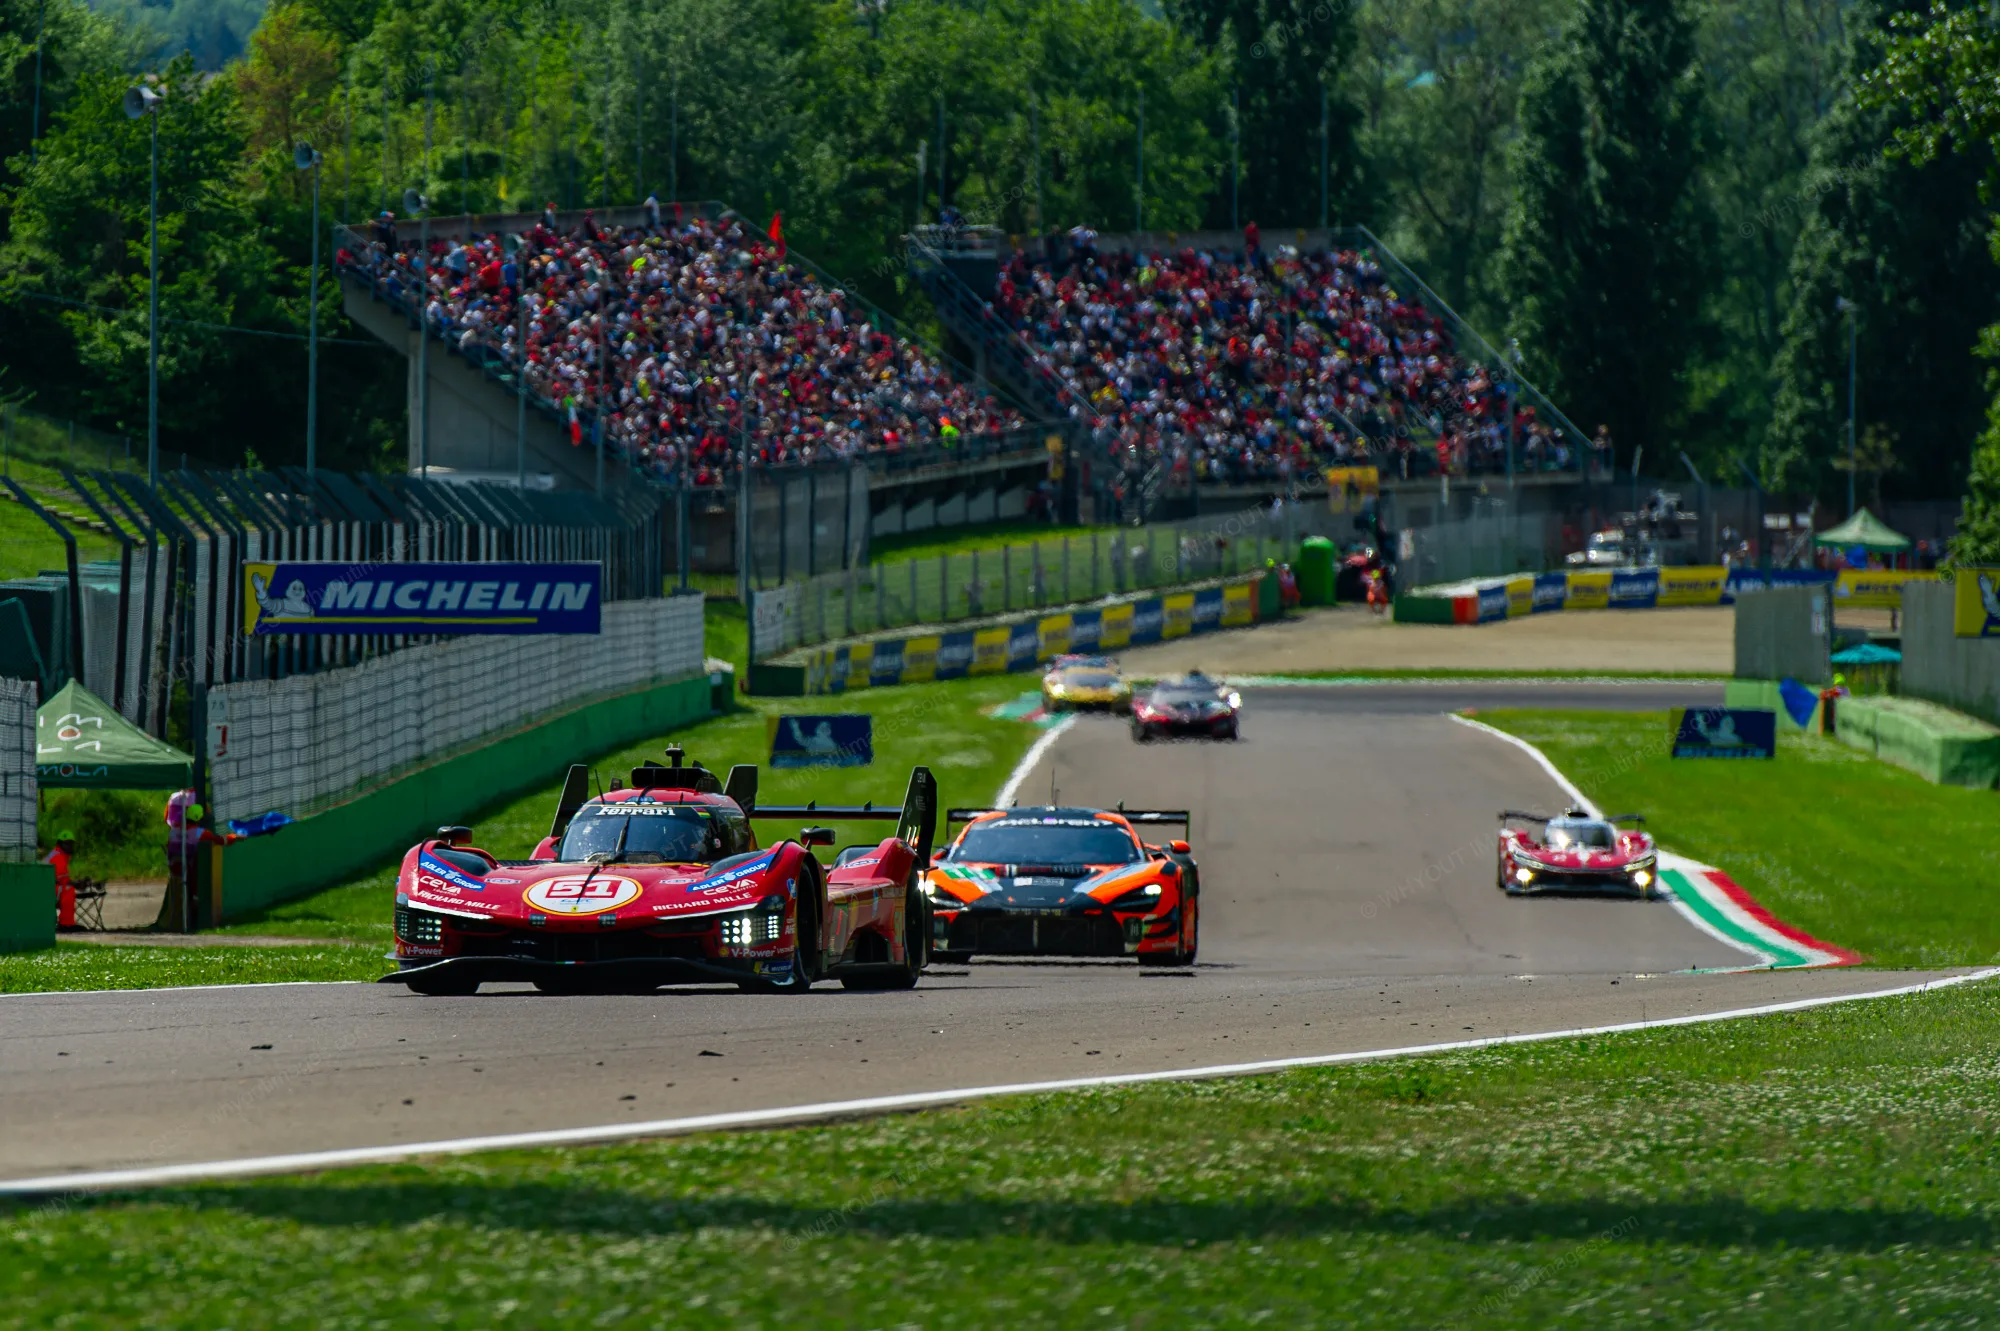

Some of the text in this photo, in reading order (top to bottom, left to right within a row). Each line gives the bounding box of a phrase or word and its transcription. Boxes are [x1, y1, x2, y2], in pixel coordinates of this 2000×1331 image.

[320, 580, 592, 610] MICHELIN
[596, 805, 676, 816] Ferrari
[420, 861, 447, 875] ADLER
[453, 876, 483, 890] GROUP
[692, 879, 726, 891] ADLER
[735, 862, 767, 877] GROUP
[549, 881, 614, 897] 51
[417, 889, 501, 911] RICHARD MILLE
[652, 892, 753, 912] RICHARD MILLE
[405, 946, 443, 955] V-Power
[731, 948, 775, 957] V-Power
